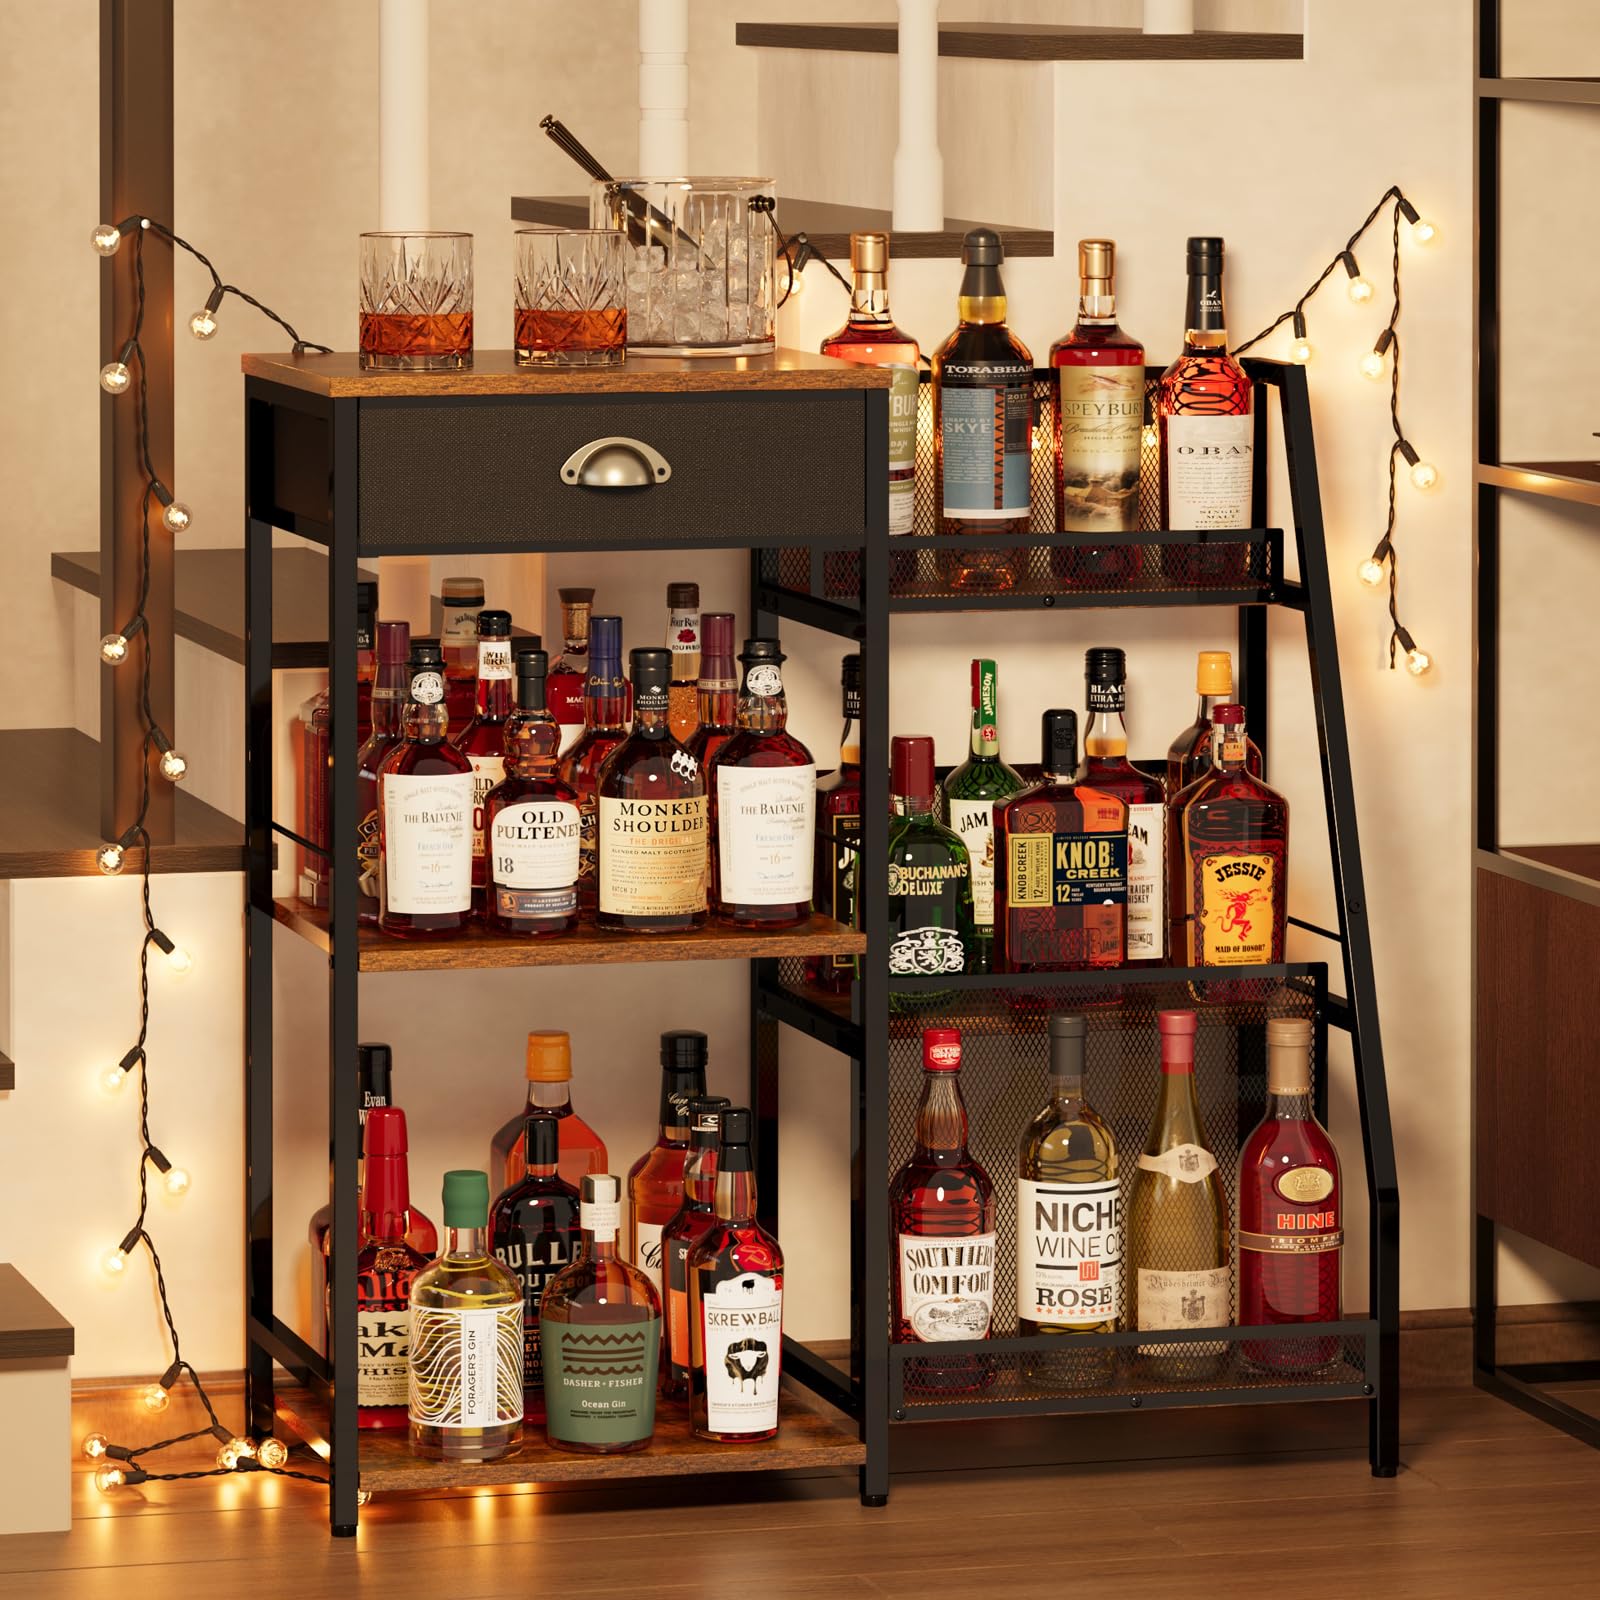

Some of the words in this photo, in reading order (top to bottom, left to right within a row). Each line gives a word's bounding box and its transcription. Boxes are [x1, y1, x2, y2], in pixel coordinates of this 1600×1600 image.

[944, 423, 992, 433] SKYE
[1176, 446, 1252, 455] OBAN
[982, 672, 993, 716] JAMESON
[522, 810, 564, 824] OLD
[620, 801, 700, 816] MONKEY
[740, 806, 757, 816] THE
[760, 803, 804, 816] BALVENIE
[404, 814, 418, 824] THE
[422, 812, 463, 824] BALVENIE
[960, 812, 988, 833] JAM
[630, 838, 646, 846] THE
[1018, 842, 1027, 872] CREEK
[1056, 840, 1110, 870] KNOB
[498, 856, 514, 874] 18
[899, 863, 968, 880] BUCHANAN'S
[1066, 868, 1120, 879] CREEK
[1214, 862, 1266, 882] JESSIE
[612, 886, 628, 894] BATCH
[1018, 874, 1027, 900] KNOB
[1034, 890, 1044, 898] 12
[1056, 884, 1070, 902] 12
[1214, 944, 1232, 953] MAID
[1232, 945, 1240, 953] OF
[364, 1090, 387, 1108] Evan
[1277, 1211, 1335, 1230] HINE
[1036, 1236, 1101, 1259] WINE
[913, 1271, 991, 1295] COMFORT
[1036, 1283, 1112, 1308] ROSÉ
[708, 1309, 779, 1327] SKREWBALL
[468, 1330, 476, 1350] GIN
[563, 1378, 600, 1388] DASHER
[608, 1376, 644, 1388] FISHER
[582, 1400, 610, 1408] Ocean
[612, 1400, 626, 1408] Gin
